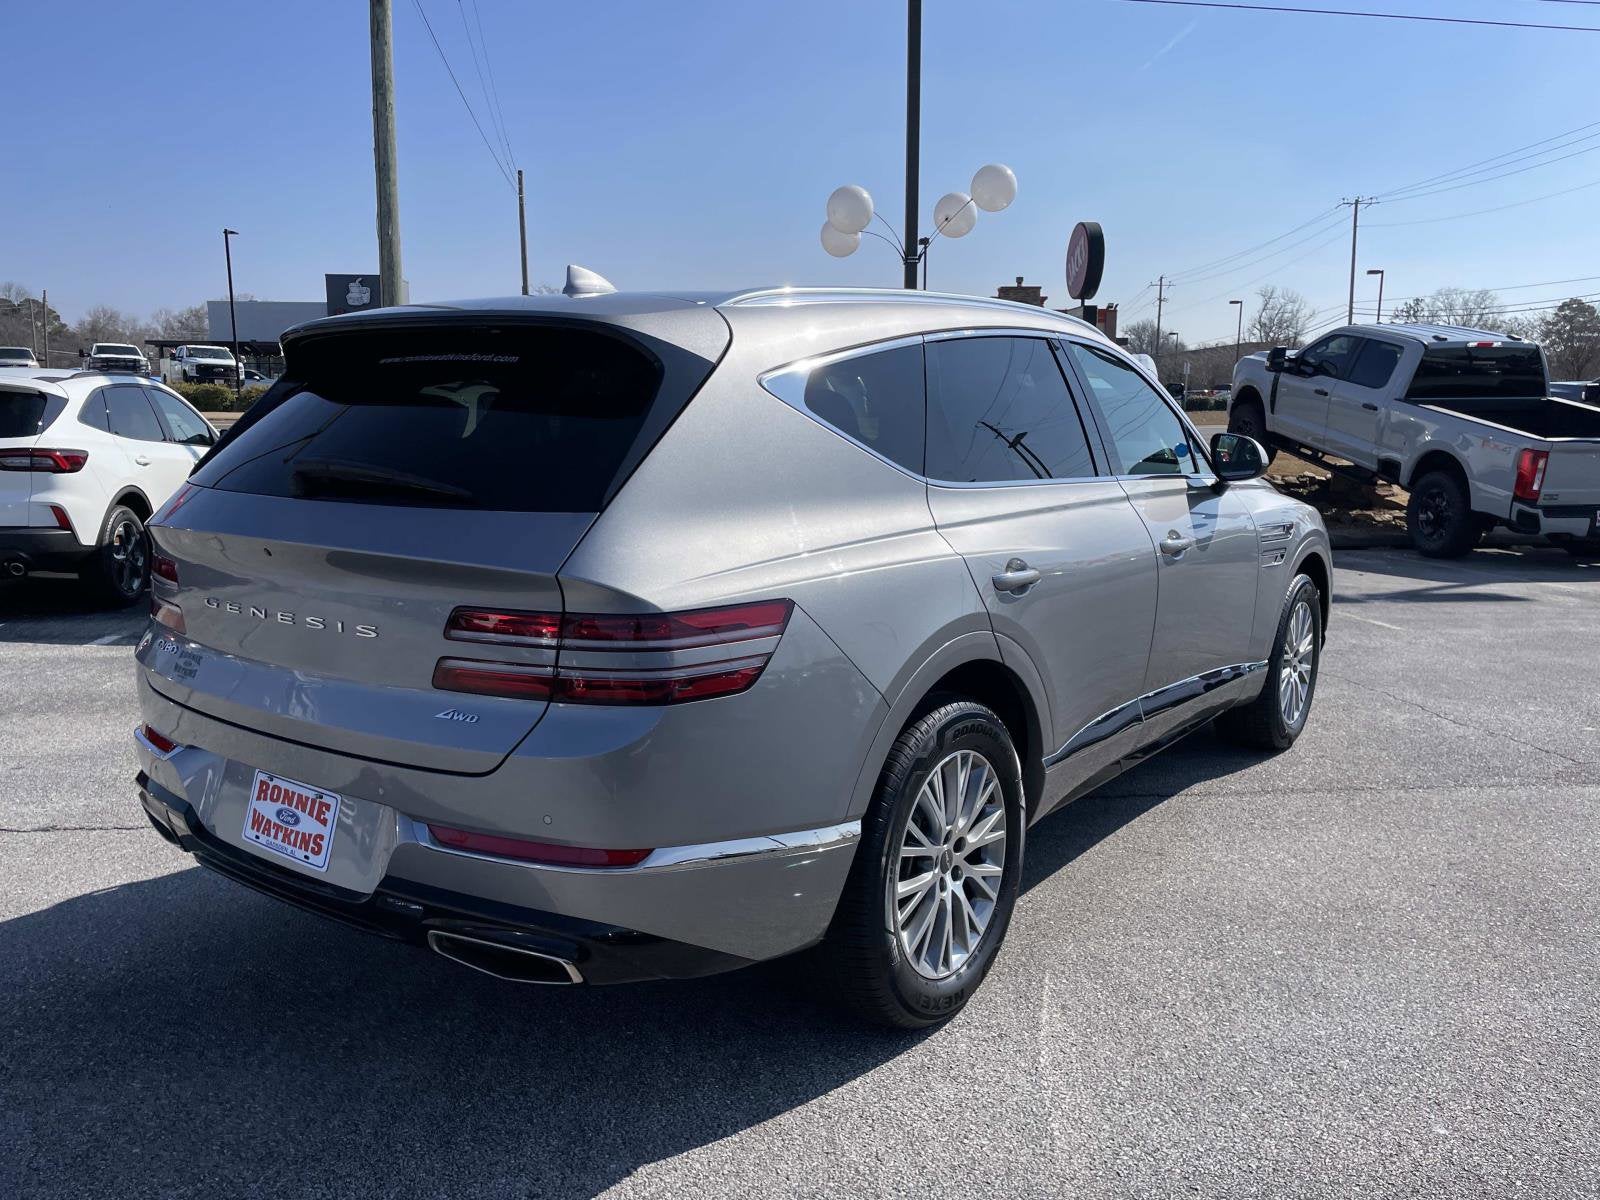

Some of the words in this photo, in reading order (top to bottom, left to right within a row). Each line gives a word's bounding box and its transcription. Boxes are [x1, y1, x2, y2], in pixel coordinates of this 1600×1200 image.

[204, 597, 379, 638] GENESIS
[256, 779, 331, 827] RONNIE
[279, 809, 298, 824] Ford
[251, 807, 324, 856] WATKINS
